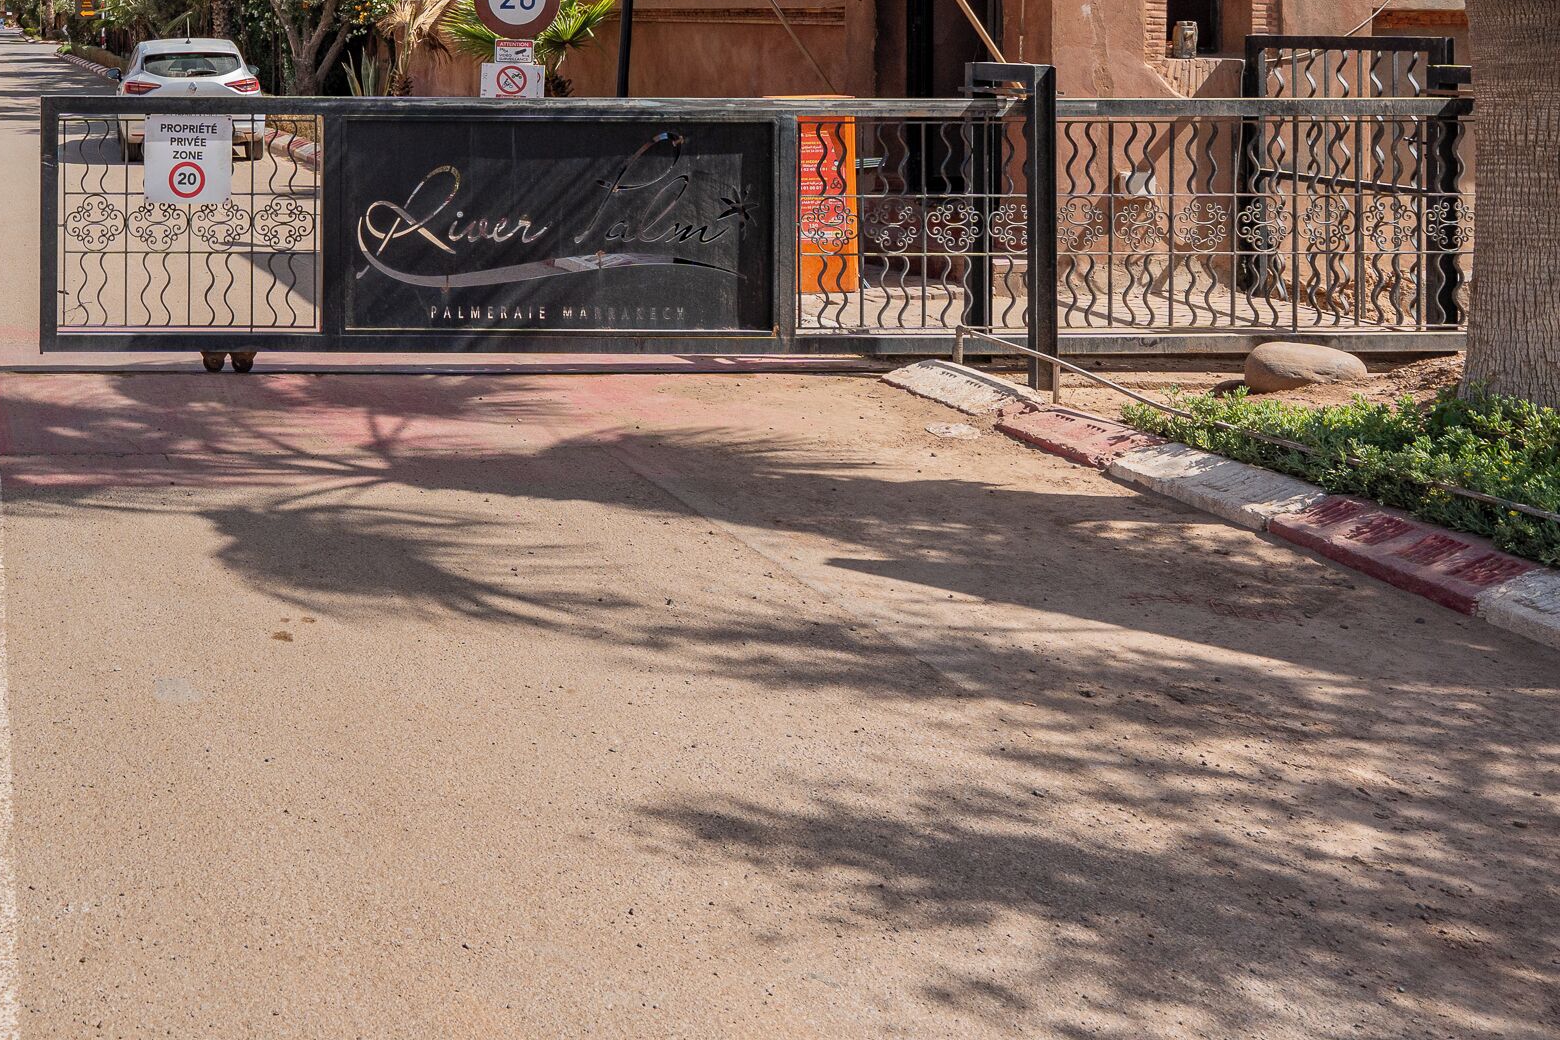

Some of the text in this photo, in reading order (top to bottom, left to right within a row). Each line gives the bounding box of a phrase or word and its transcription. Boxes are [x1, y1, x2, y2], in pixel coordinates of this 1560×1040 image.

[160, 122, 218, 134] PROPRIÉTÉ
[169, 136, 207, 147] PRIVÉE
[172, 151, 203, 160] ZONE
[177, 172, 197, 186] 20
[364, 131, 731, 255] River Palm
[430, 305, 547, 320] PALMERAIE
